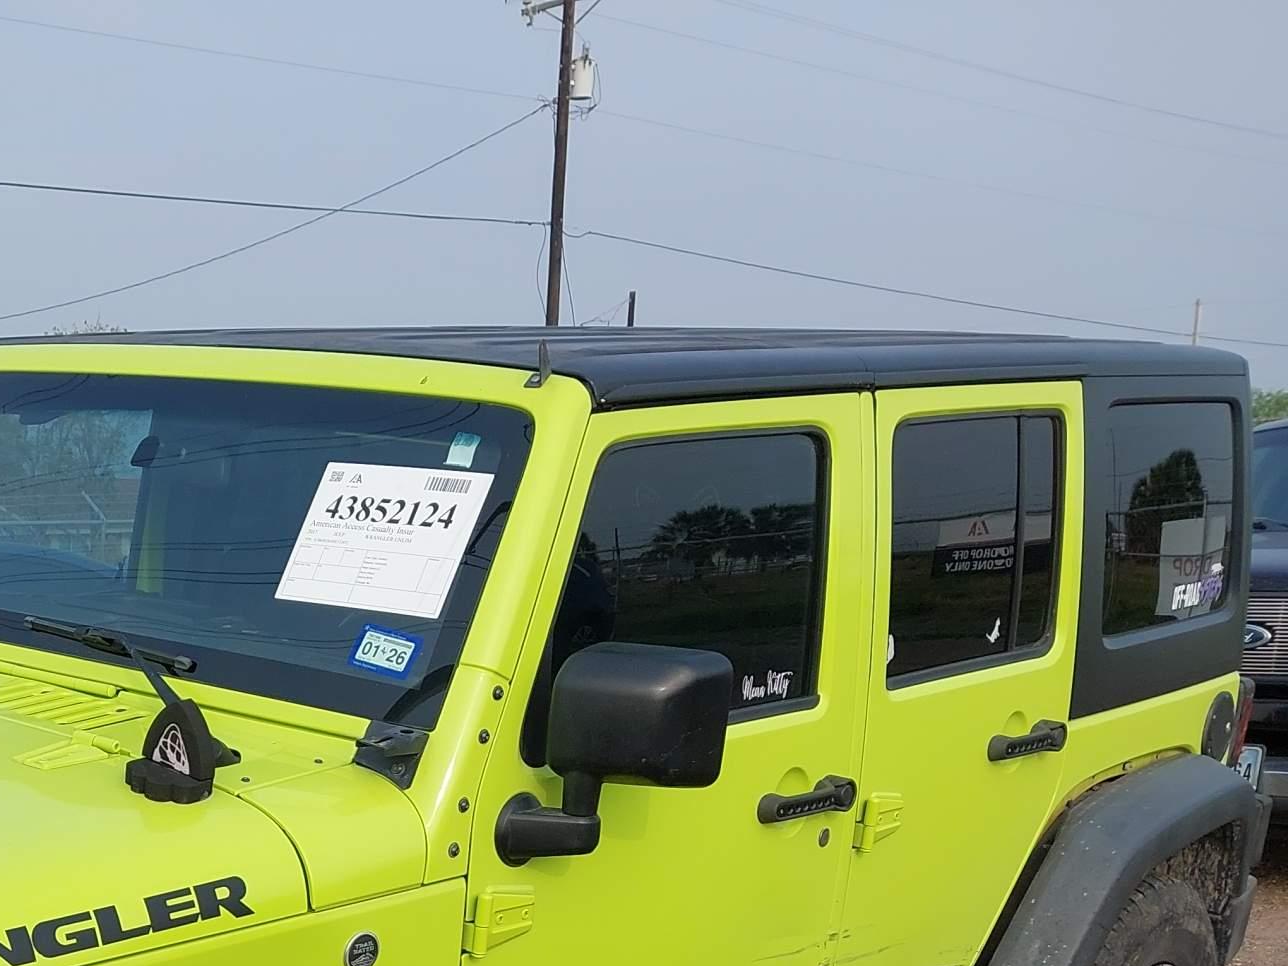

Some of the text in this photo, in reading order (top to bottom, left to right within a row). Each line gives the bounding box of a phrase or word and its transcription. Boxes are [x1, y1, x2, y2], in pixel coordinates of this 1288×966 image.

[325, 494, 458, 529] 43852124
[310, 519, 342, 530] American
[342, 522, 365, 531] Access
[366, 525, 397, 536] Casualty
[361, 641, 407, 665] 01 26
